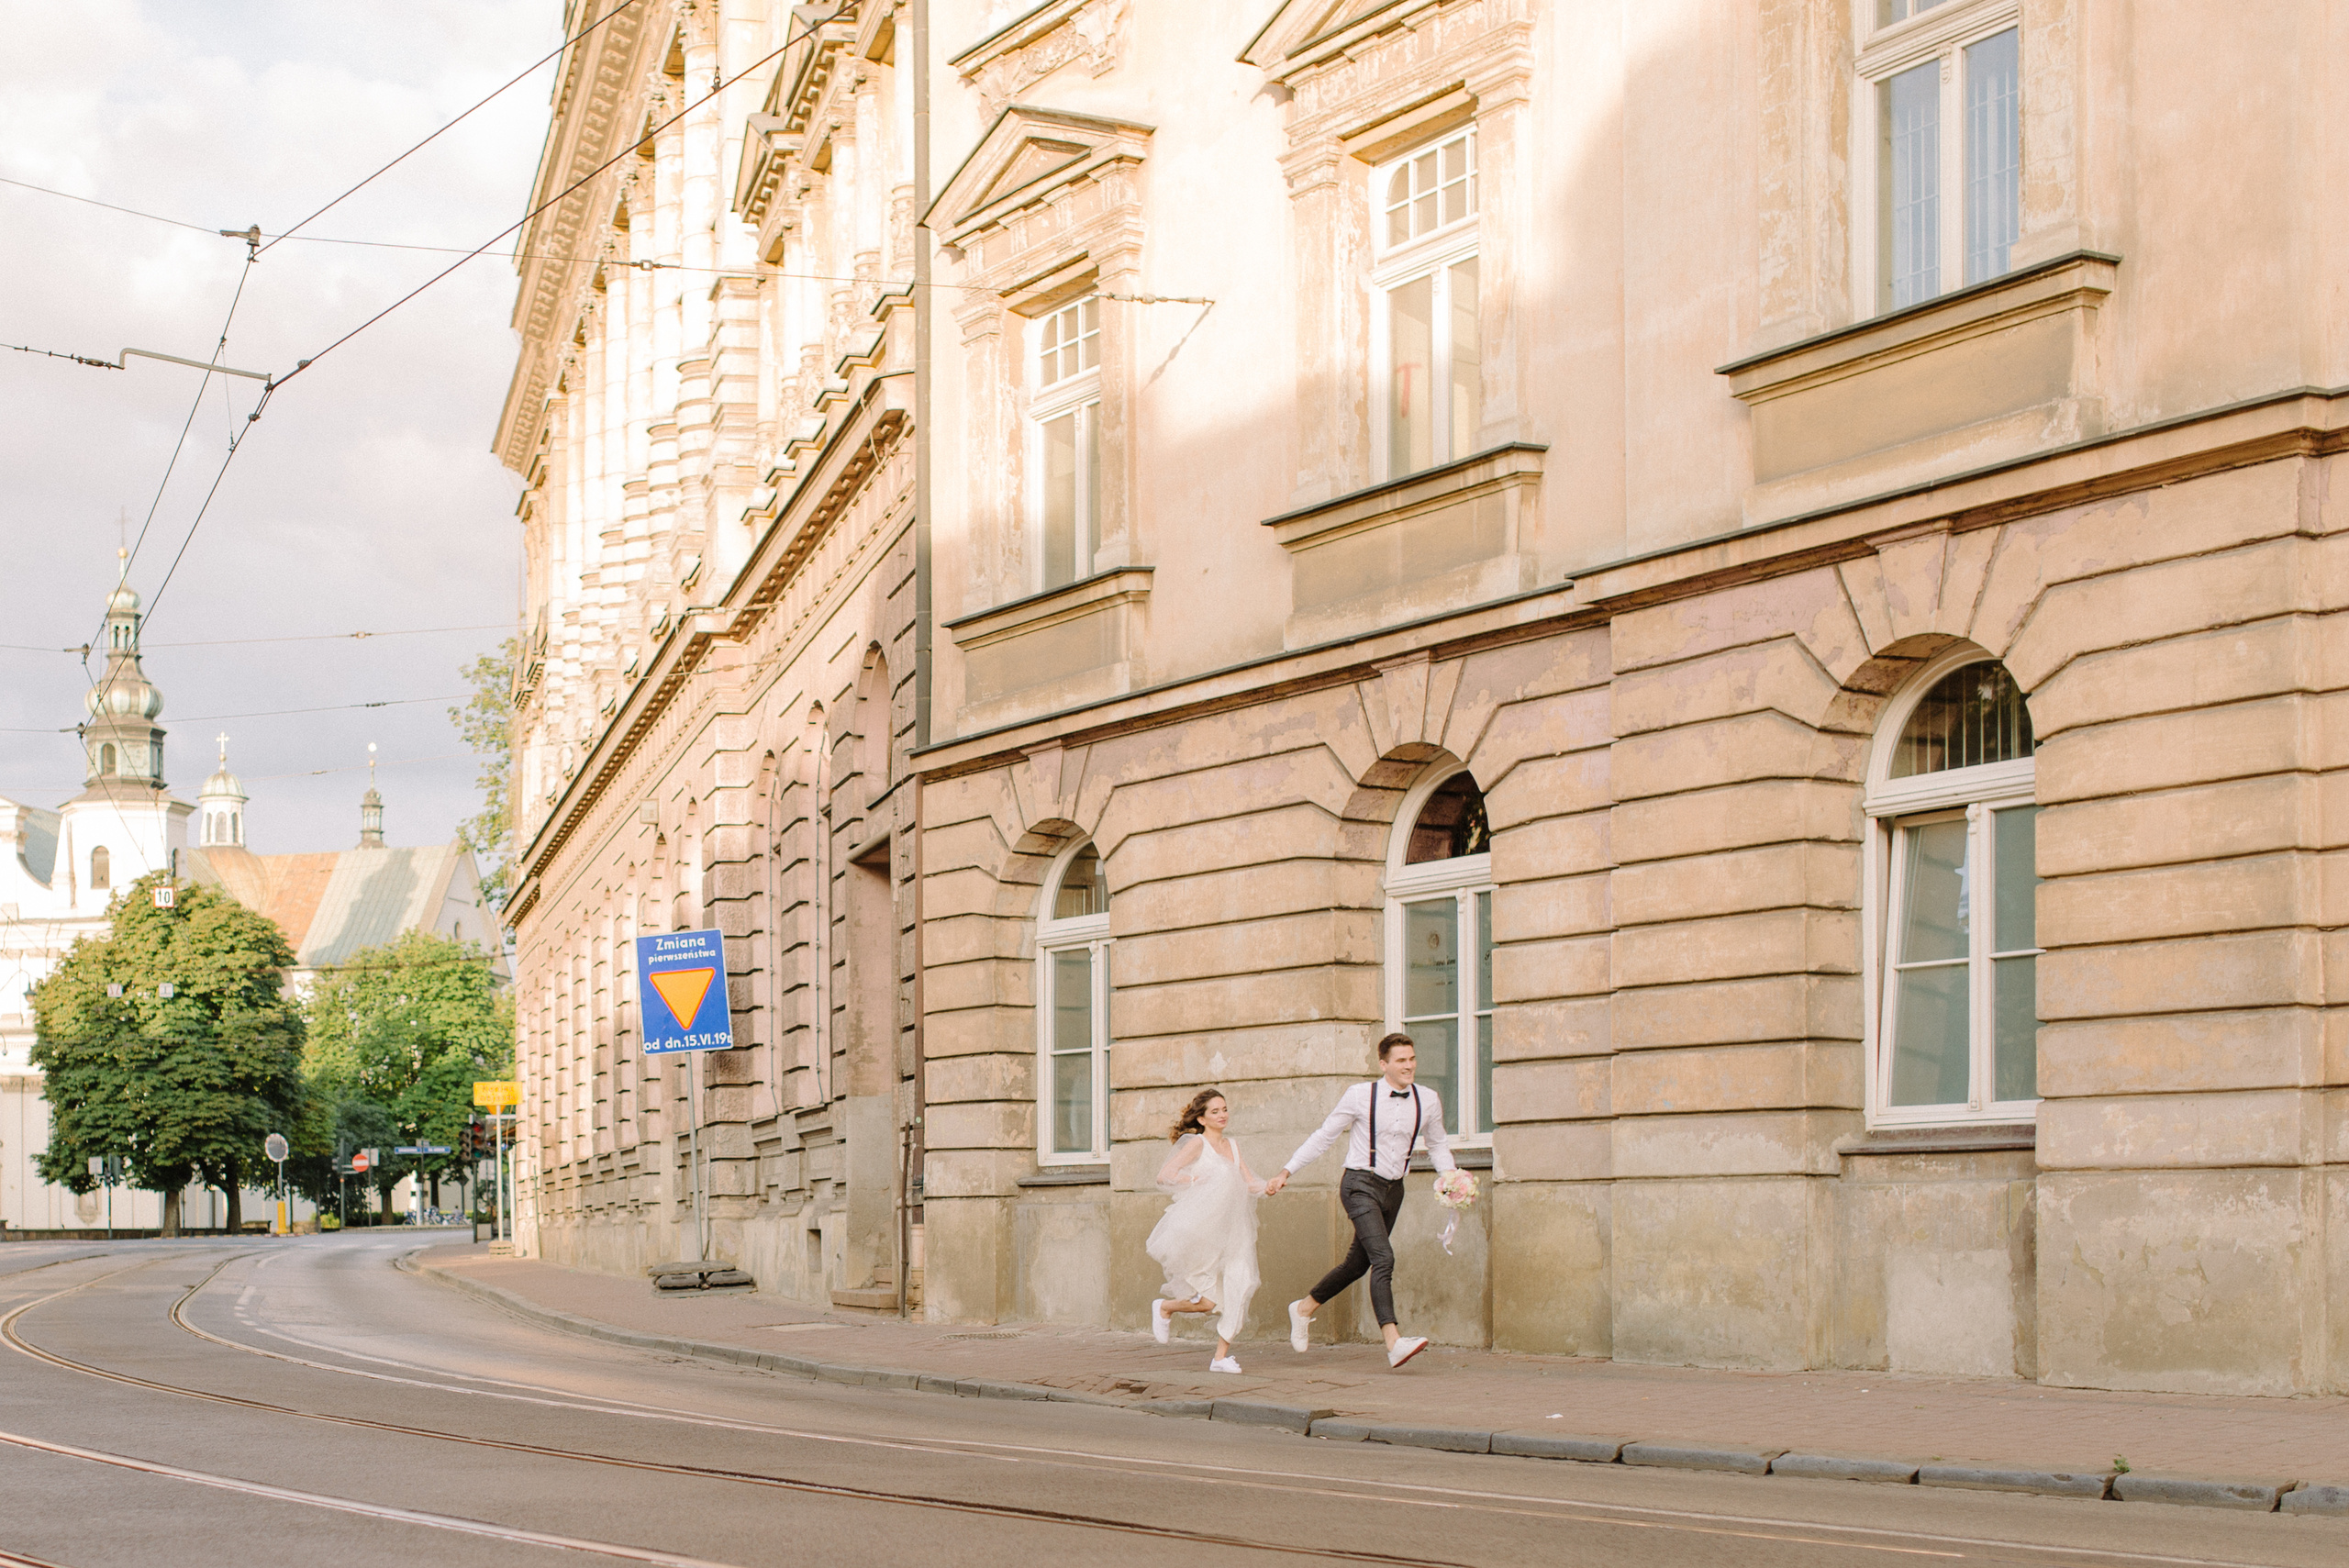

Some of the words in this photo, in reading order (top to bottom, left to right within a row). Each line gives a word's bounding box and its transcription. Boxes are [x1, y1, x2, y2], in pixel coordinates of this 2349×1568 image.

[157, 889, 171, 904] 10
[655, 937, 706, 951] Zmiana
[648, 950, 716, 965] pierwszeństwa
[643, 1038, 660, 1051] od
